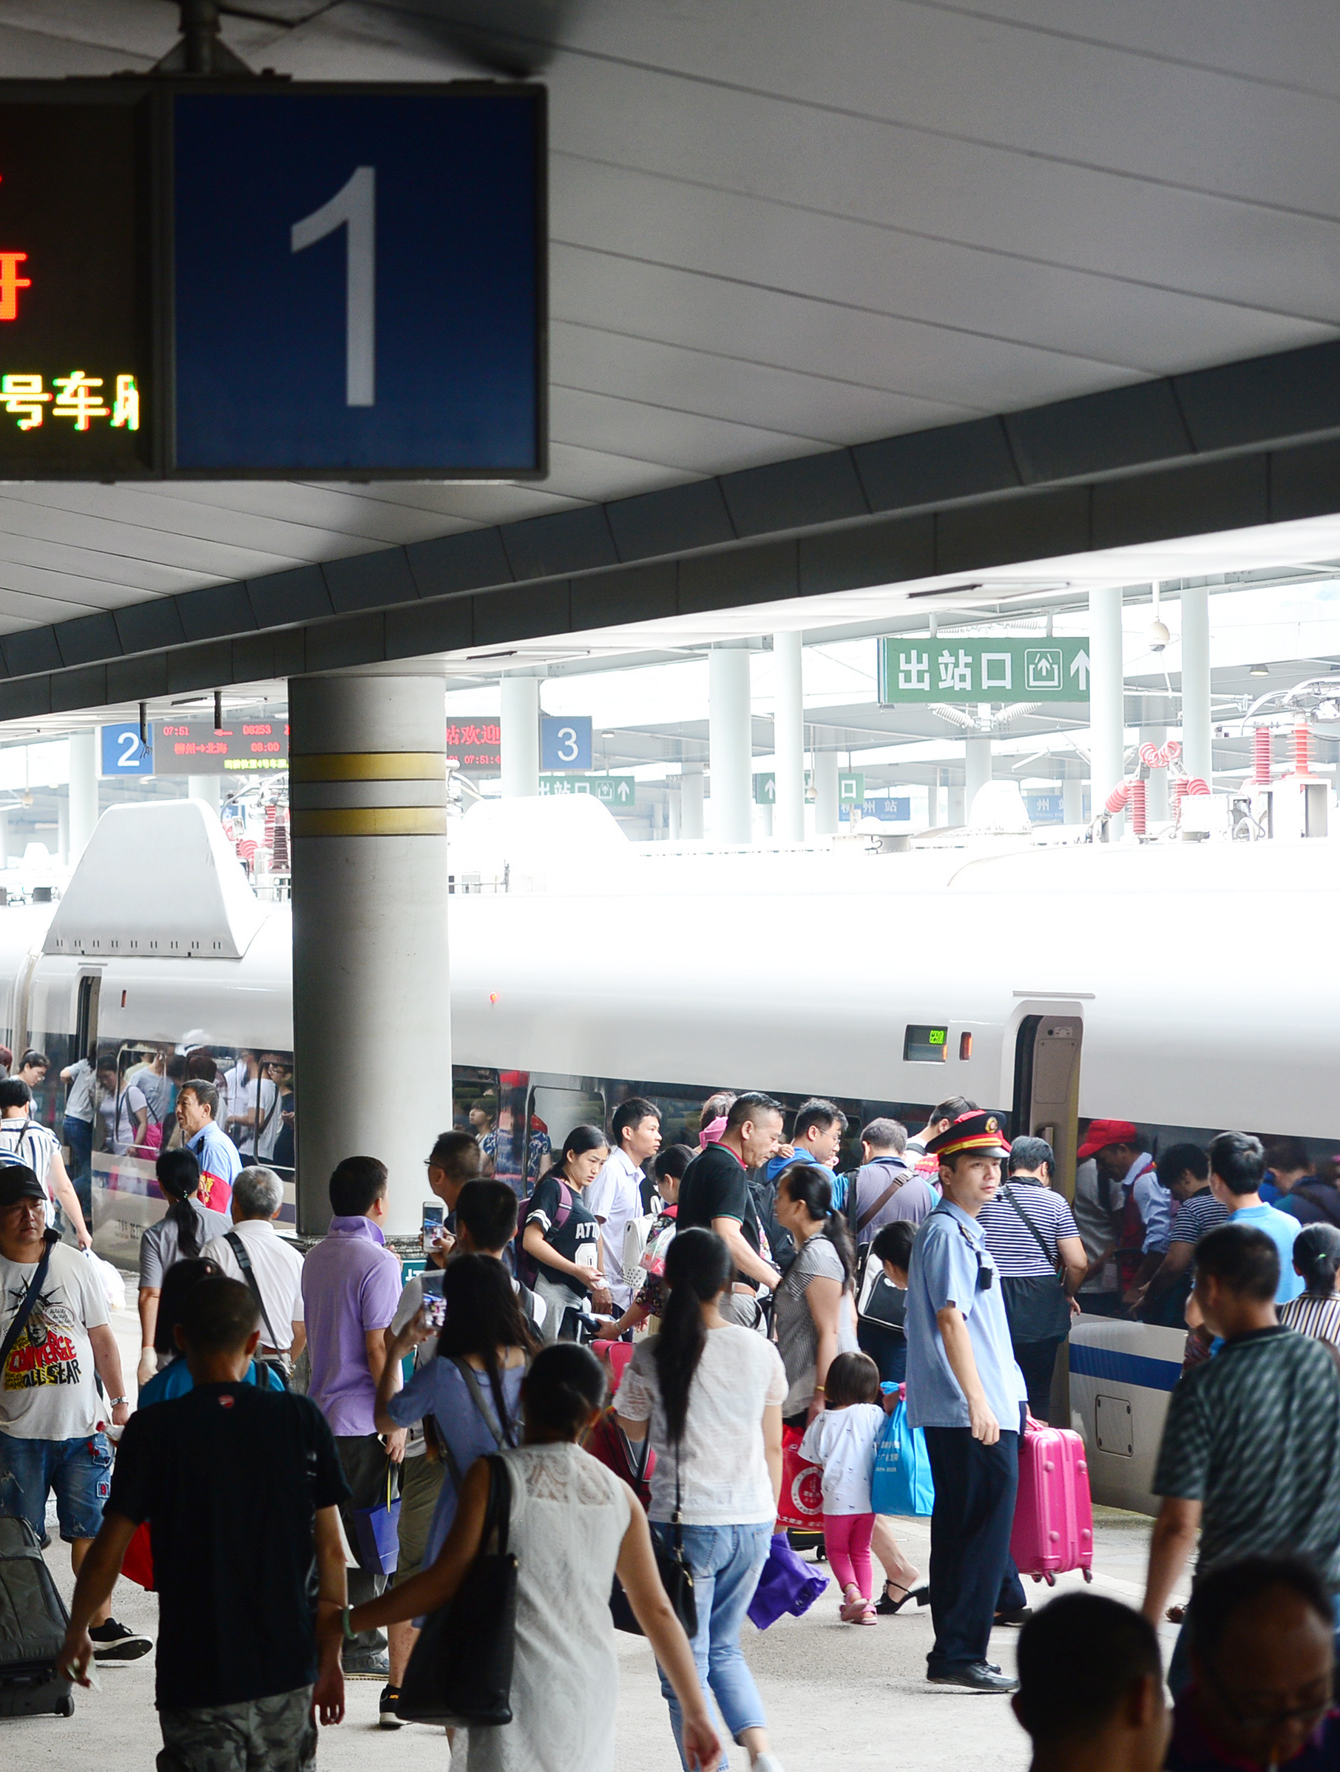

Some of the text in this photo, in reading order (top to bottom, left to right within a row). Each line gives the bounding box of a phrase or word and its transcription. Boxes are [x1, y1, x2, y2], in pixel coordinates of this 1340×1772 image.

[291, 166, 375, 407] 1
[898, 649, 1012, 692] 出站口
[162, 726, 190, 737] 07:51
[556, 727, 579, 762] 3
[117, 732, 140, 767] 2
